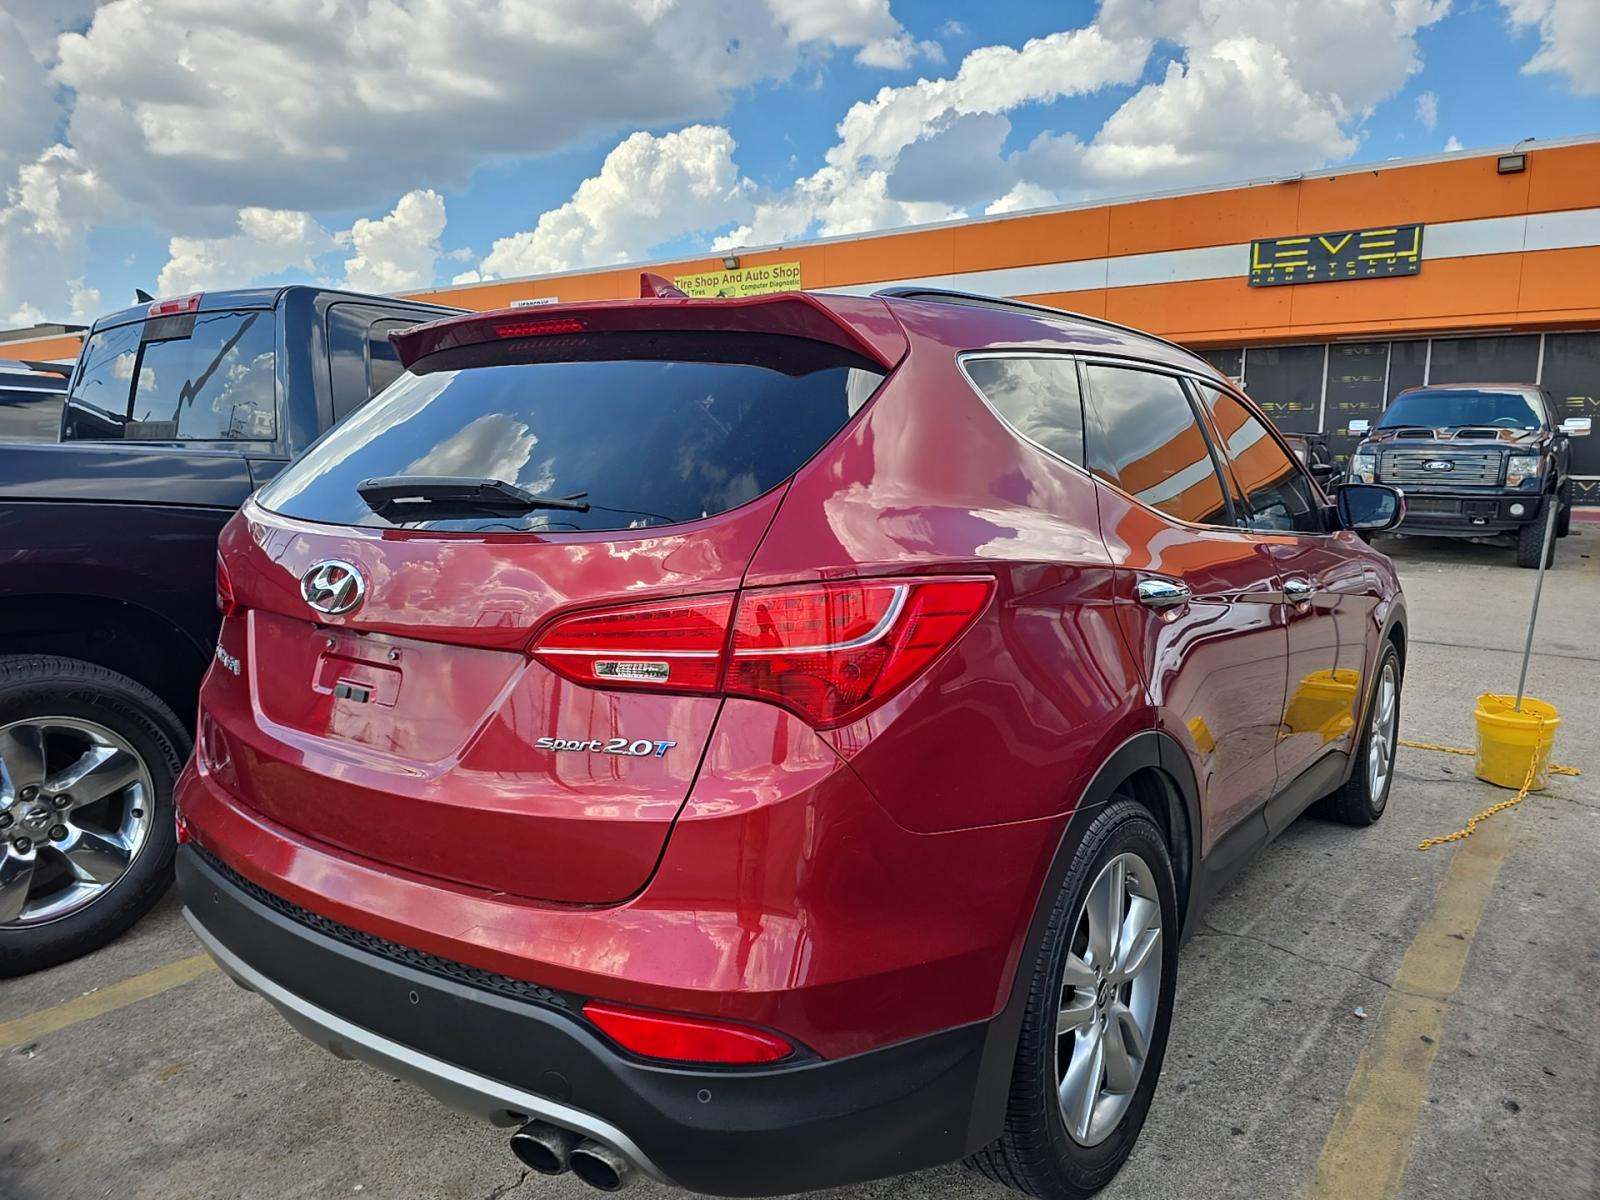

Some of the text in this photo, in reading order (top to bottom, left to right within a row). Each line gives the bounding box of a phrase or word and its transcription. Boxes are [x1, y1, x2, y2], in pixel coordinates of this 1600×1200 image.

[1253, 227, 1420, 269] LEVEL
[675, 266, 800, 290] Tire Shop And Auto Shop
[740, 279, 800, 291] Computer Diagnostic
[535, 737, 677, 758] Sport 2.0T
